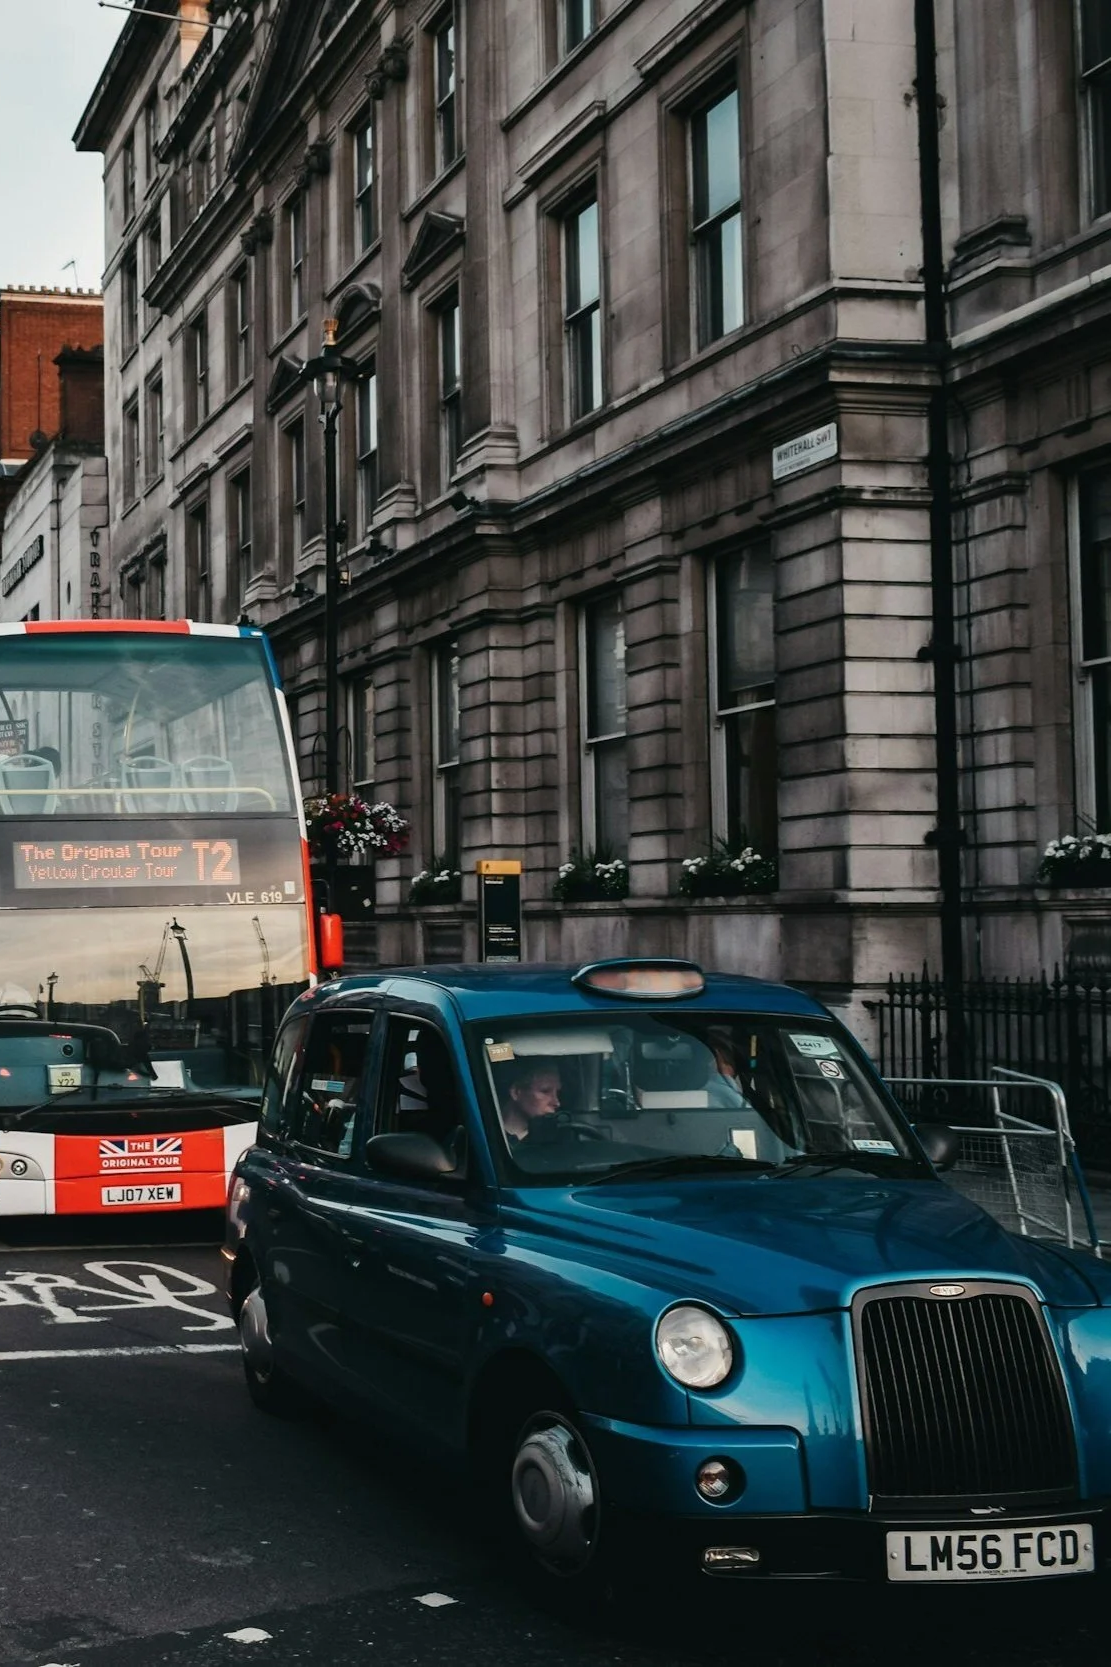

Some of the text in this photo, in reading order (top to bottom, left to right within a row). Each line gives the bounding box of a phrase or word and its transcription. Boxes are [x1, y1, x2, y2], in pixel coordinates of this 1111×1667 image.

[776, 437, 815, 462] WHITEHALL
[20, 842, 183, 862] The Original Tour
[192, 841, 234, 881] T2
[28, 863, 178, 882] Yellow Circular Tour
[226, 891, 283, 904] VLE 619
[130, 1142, 151, 1151] THE
[102, 1157, 180, 1168] ORIGINAL TOUR
[107, 1187, 174, 1202] LJ07 XEW
[904, 1530, 1079, 1571] LM56 FCD
